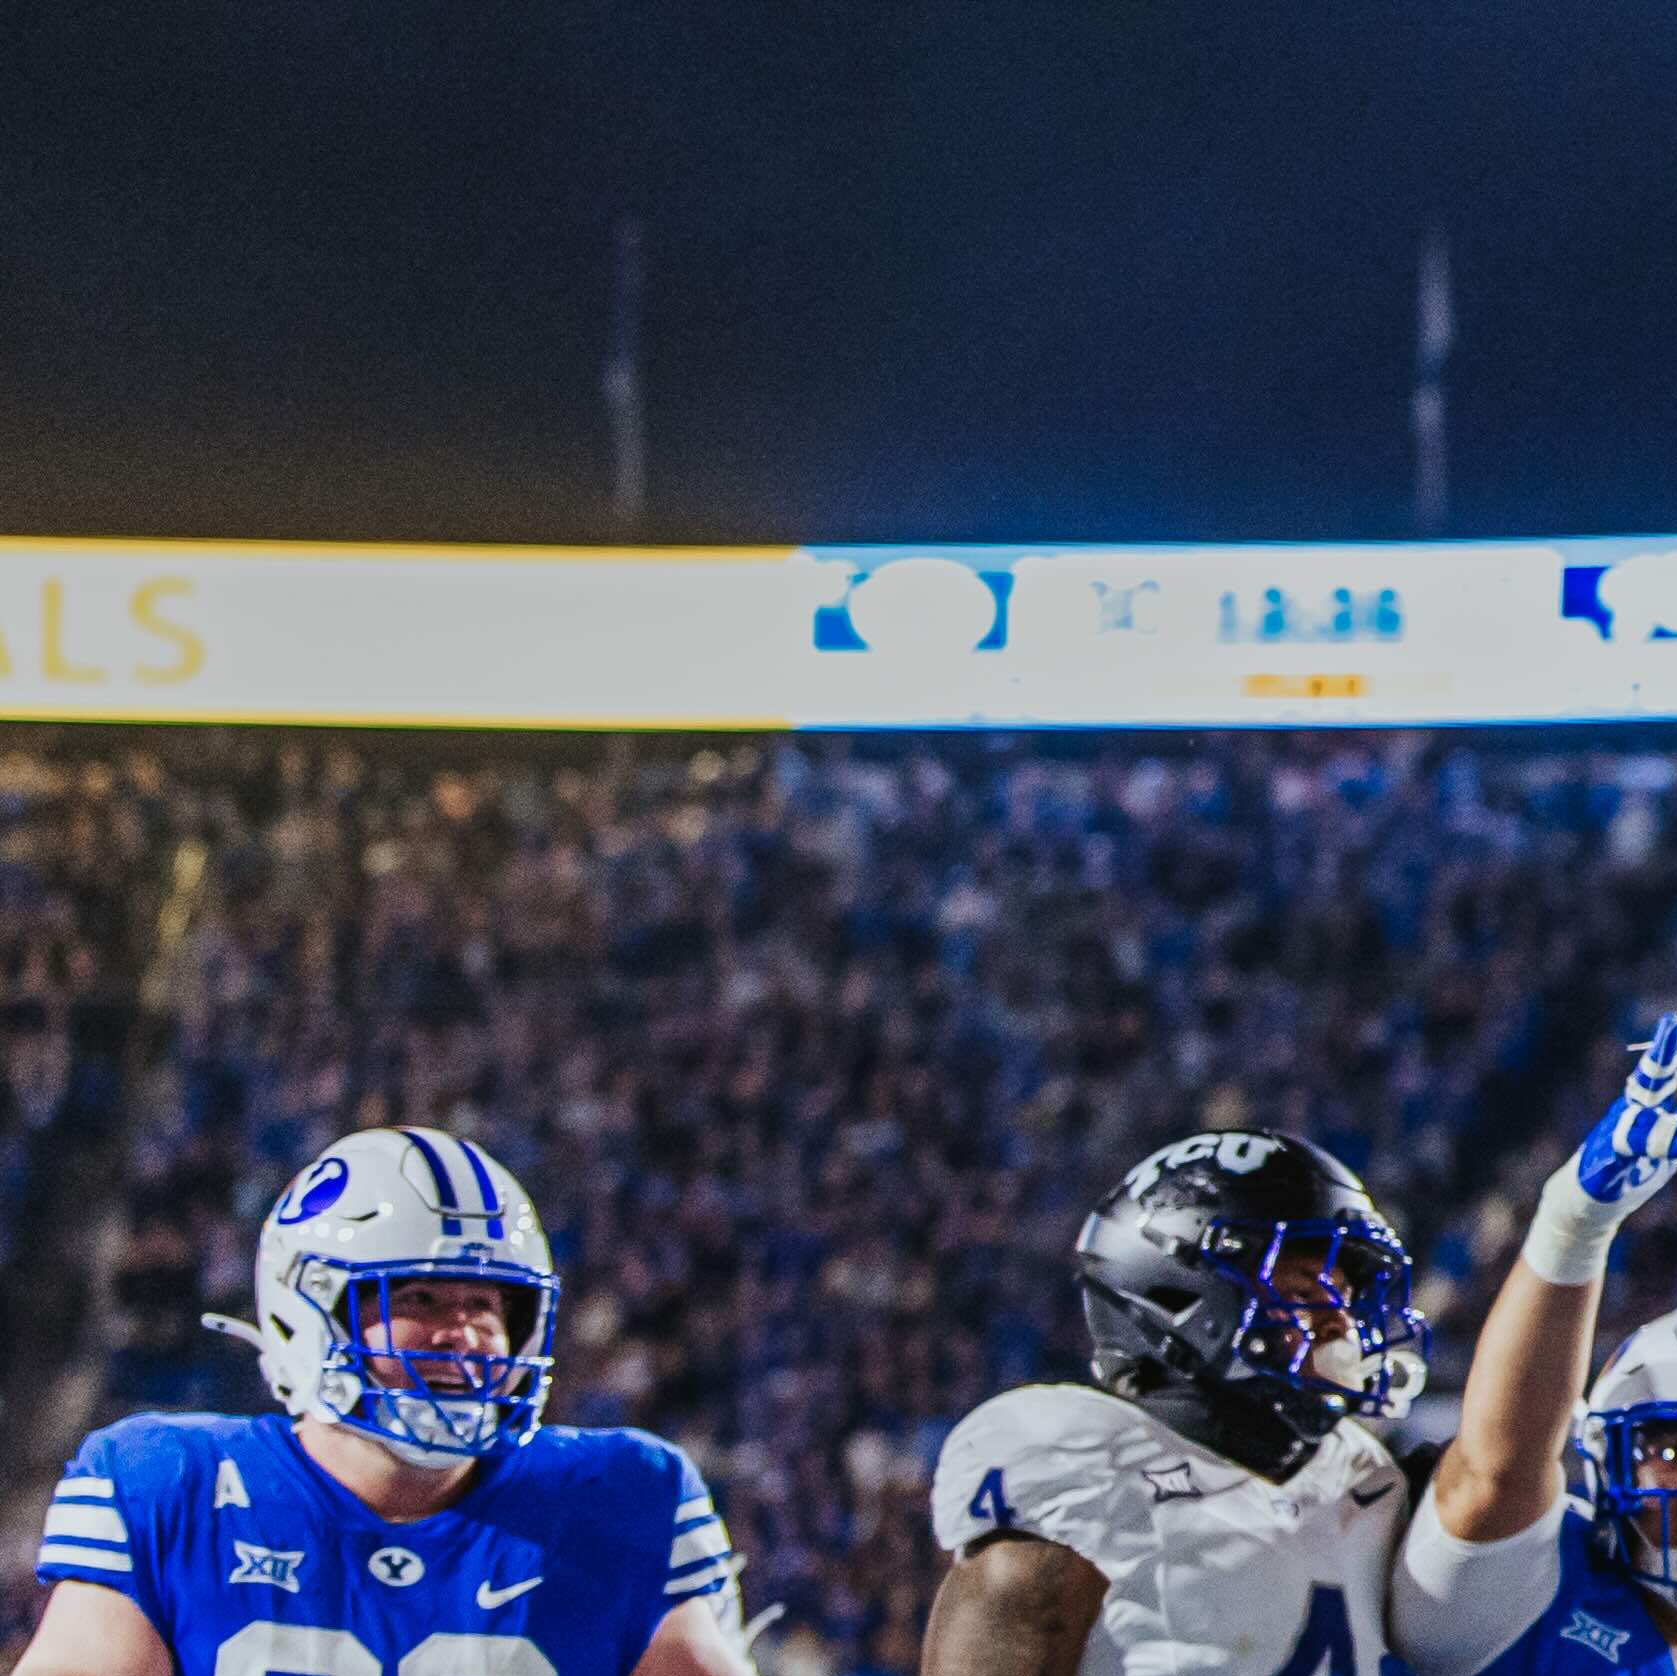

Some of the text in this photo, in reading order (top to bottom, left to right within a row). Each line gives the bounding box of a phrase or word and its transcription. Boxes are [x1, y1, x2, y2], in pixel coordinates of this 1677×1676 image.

[1124, 1131, 1286, 1201] TCU
[213, 1457, 251, 1509] A
[969, 1467, 1016, 1530] 4
